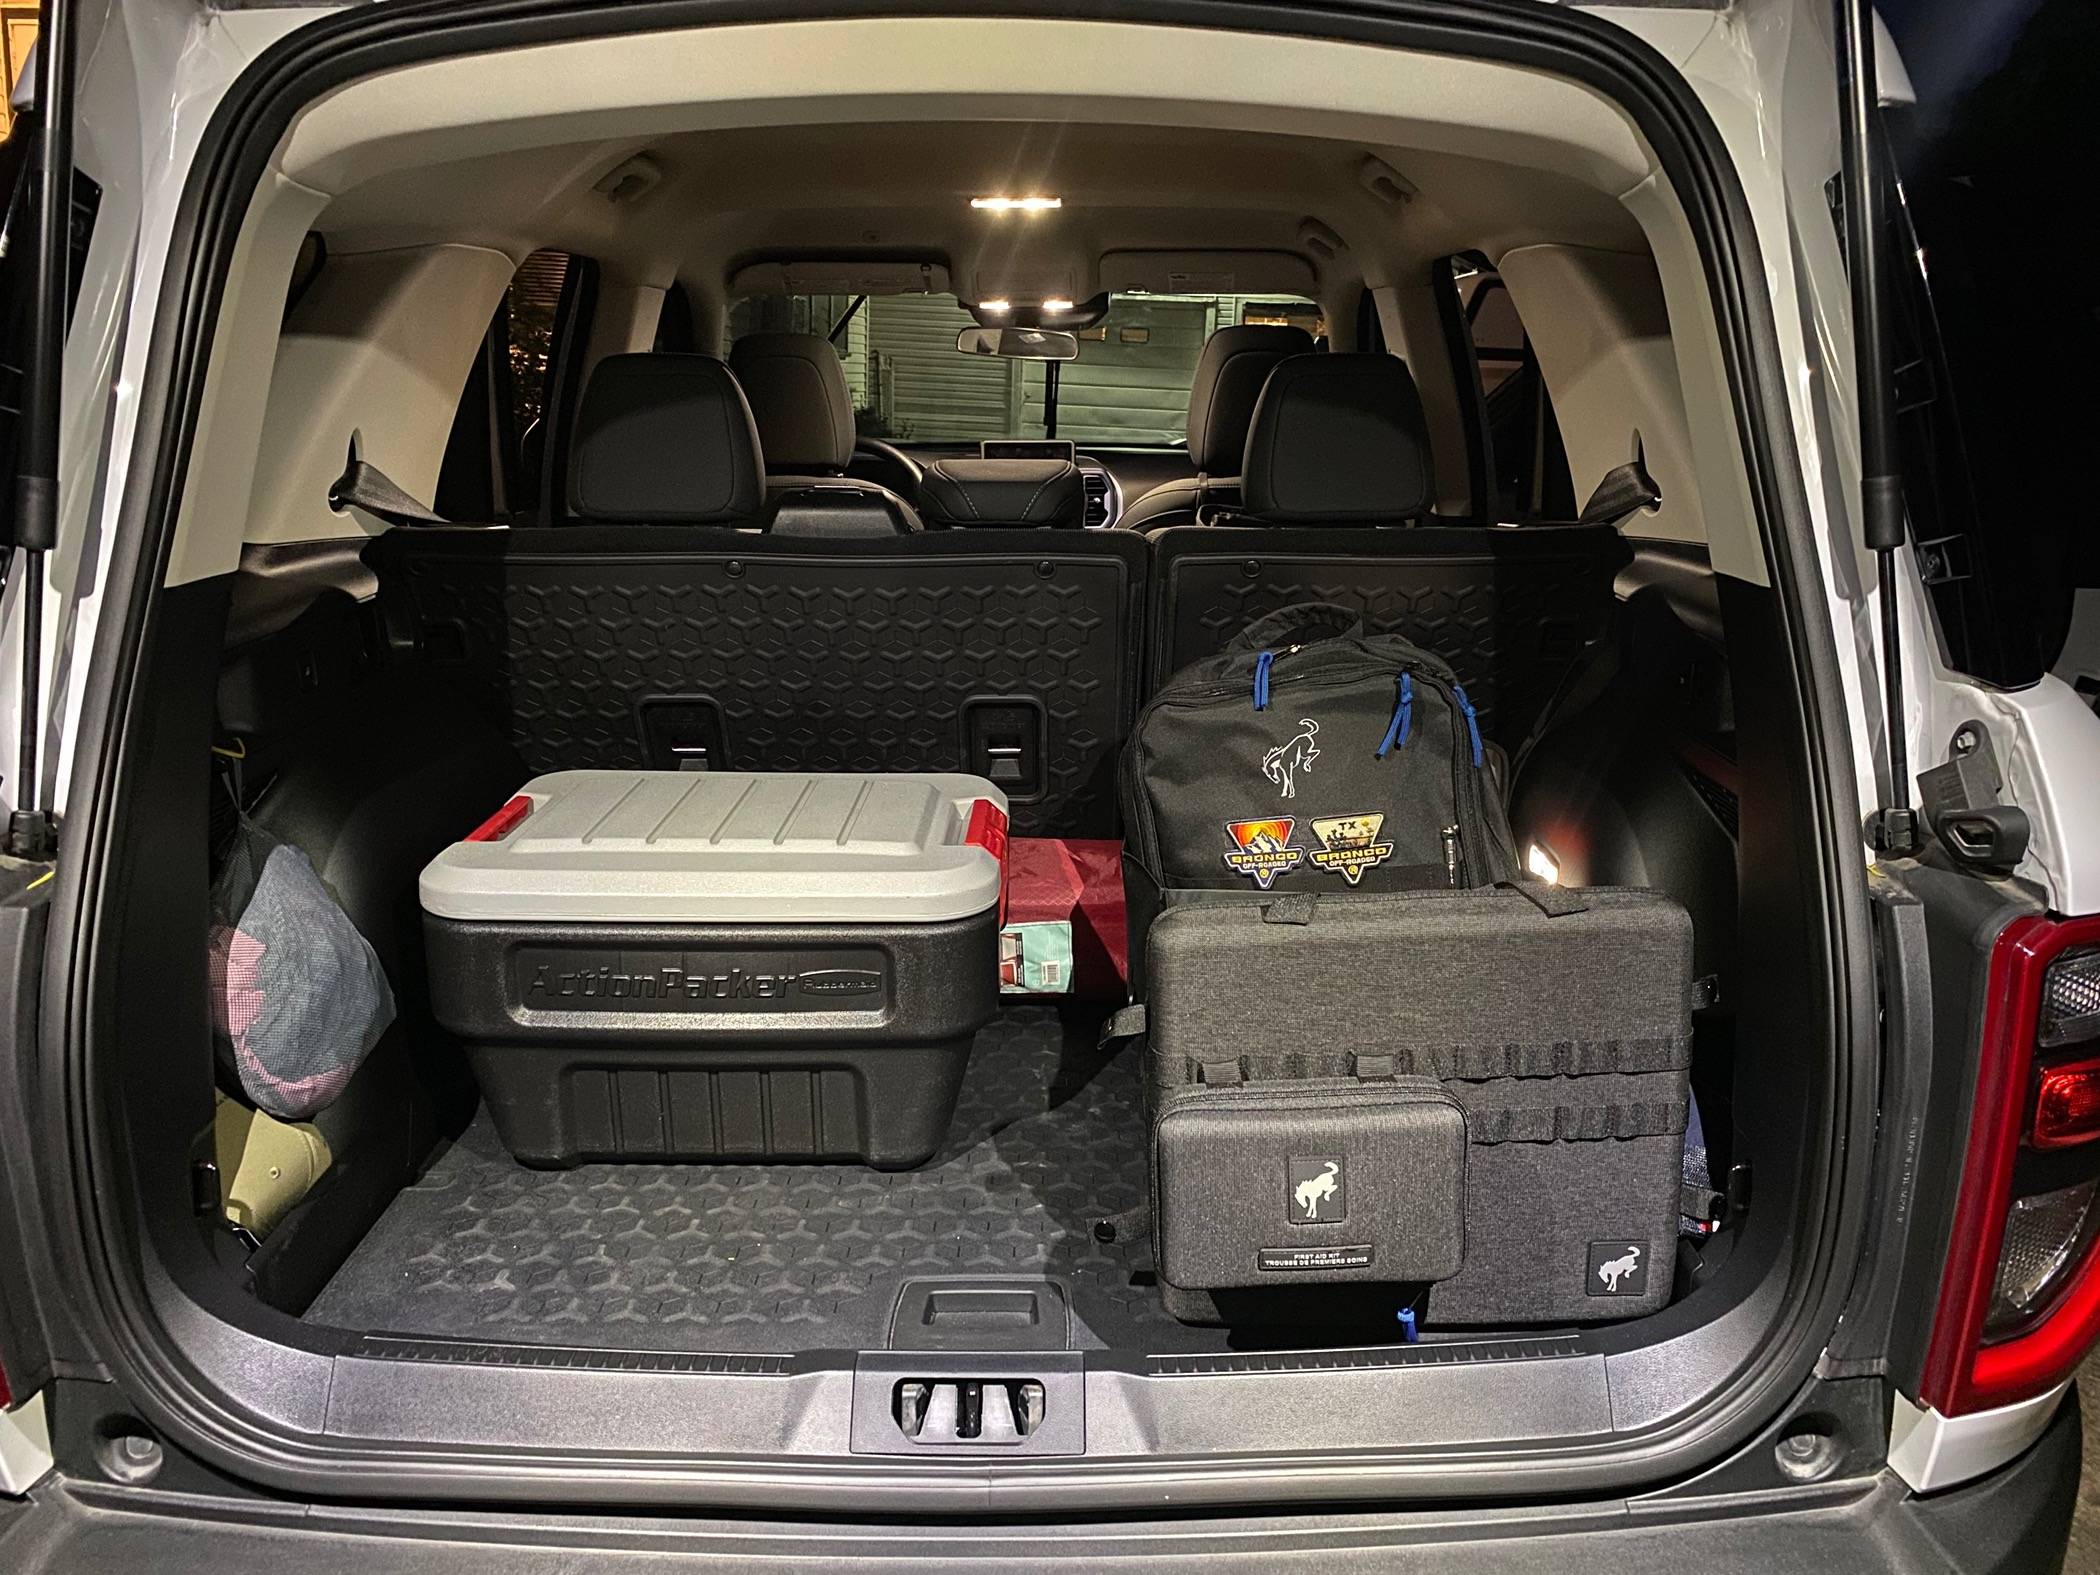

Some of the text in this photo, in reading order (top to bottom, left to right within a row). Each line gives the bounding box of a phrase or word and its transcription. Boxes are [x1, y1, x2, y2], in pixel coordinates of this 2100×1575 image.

[1338, 820, 1357, 831] TX
[1231, 852, 1298, 863] BRONCO
[1316, 847, 1387, 862] BRONCO
[527, 965, 798, 1000] ActionPacker
[1310, 1258, 1345, 1266] PREMIERS
[1346, 1256, 1368, 1264] SOINS
